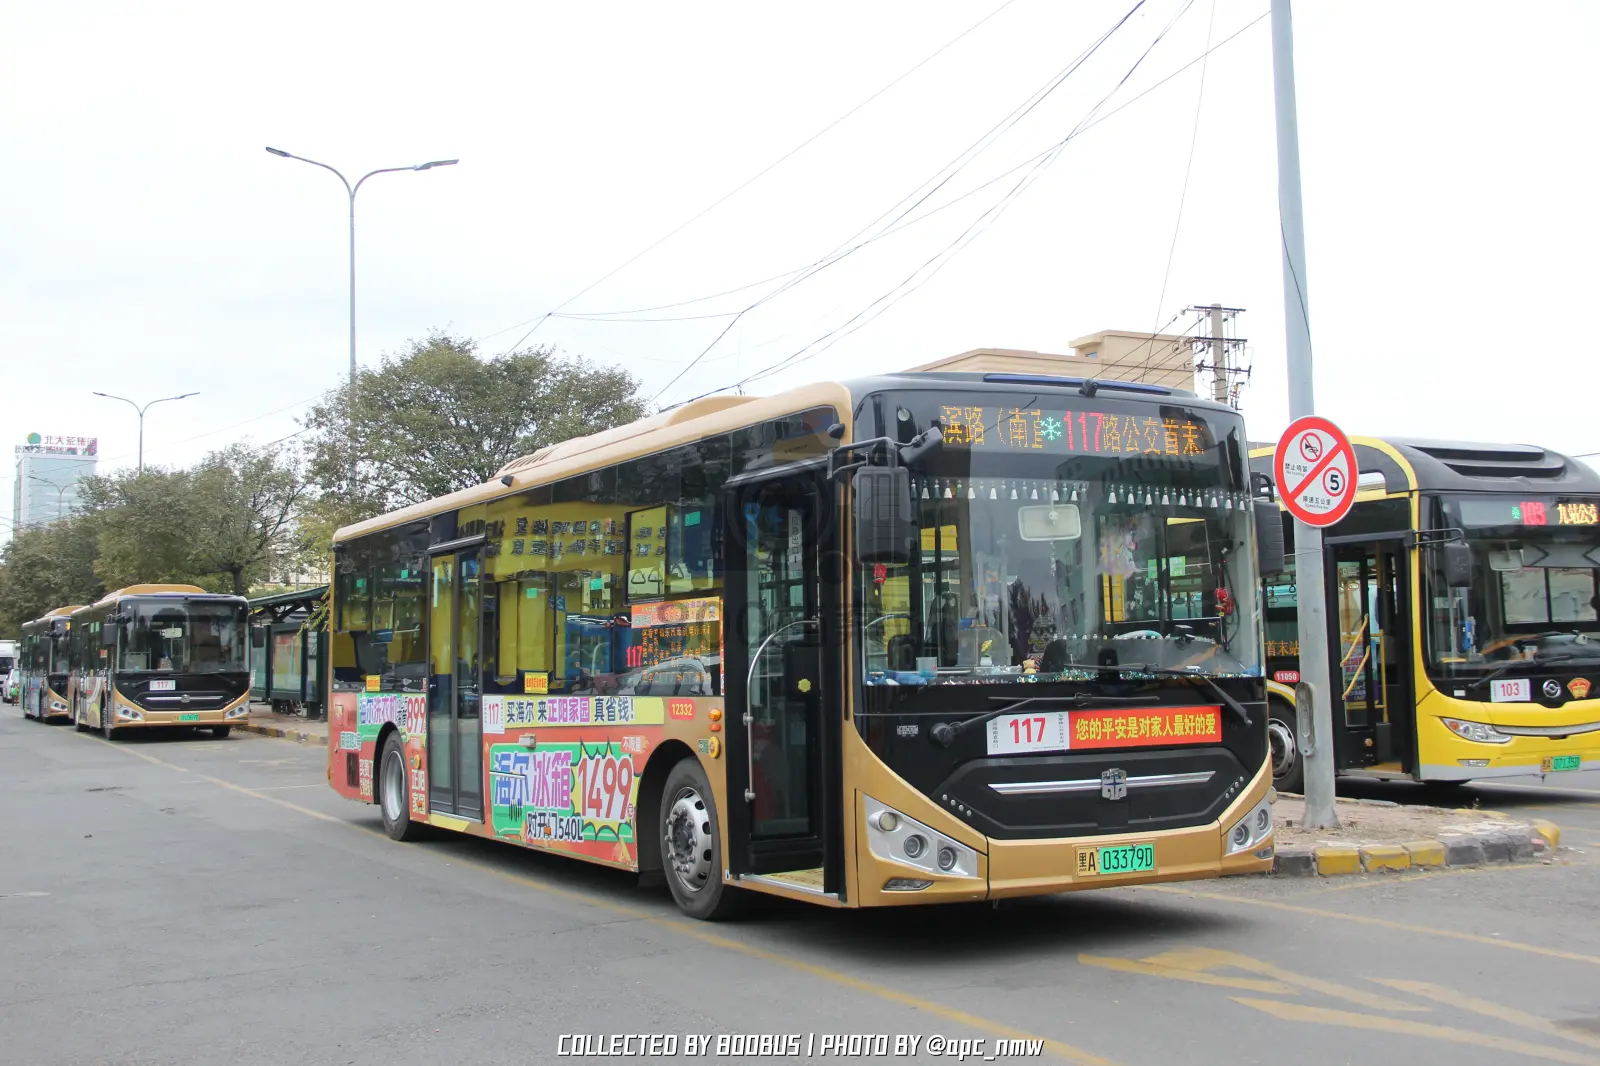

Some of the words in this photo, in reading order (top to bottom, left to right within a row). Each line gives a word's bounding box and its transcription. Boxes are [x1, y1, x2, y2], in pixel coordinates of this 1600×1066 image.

[1064, 410, 1205, 456] 117路公交首末
[1329, 474, 1340, 491] 5
[1520, 501, 1547, 526] 103
[626, 645, 643, 667] 117
[1500, 682, 1520, 696] 103
[406, 697, 426, 734] 899
[488, 703, 499, 725] 117
[506, 699, 535, 724] 买海尔
[671, 703, 693, 716] 12332
[1009, 717, 1046, 744] 117
[1075, 713, 1217, 741] 您的平安是对家人最好的爱
[494, 751, 572, 808] 海尔冰箱
[577, 756, 633, 820] 1499
